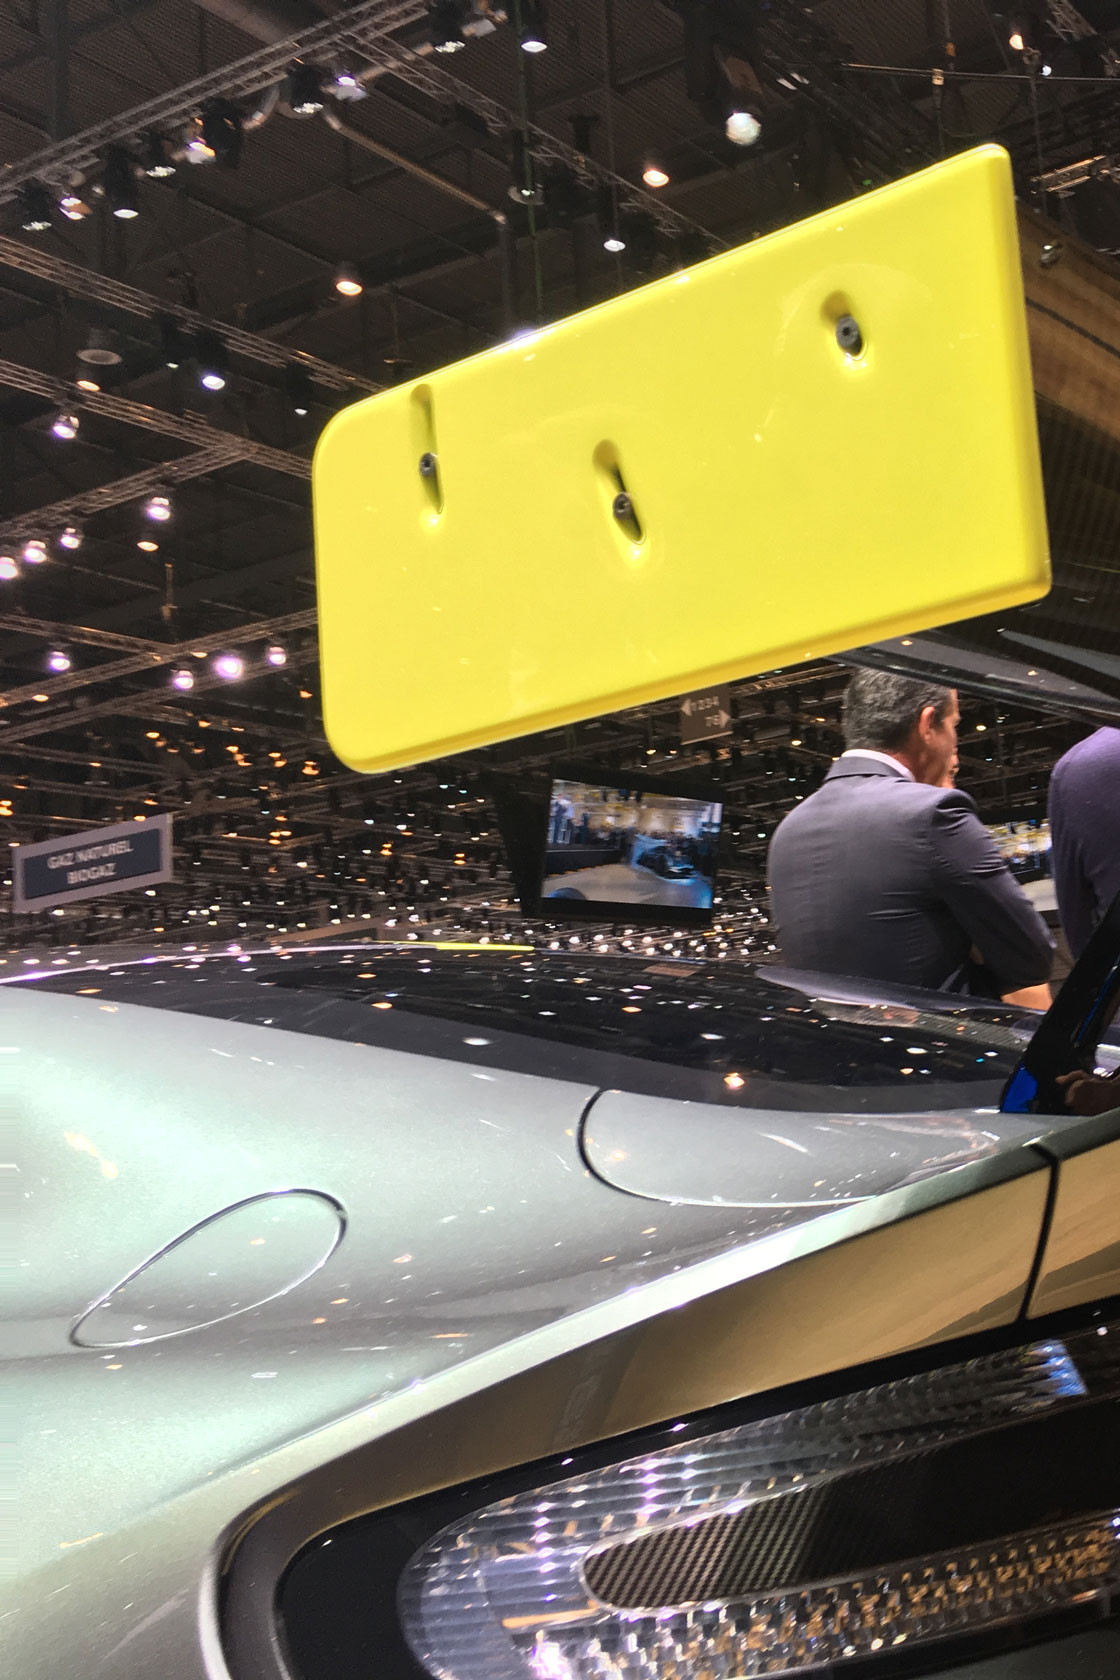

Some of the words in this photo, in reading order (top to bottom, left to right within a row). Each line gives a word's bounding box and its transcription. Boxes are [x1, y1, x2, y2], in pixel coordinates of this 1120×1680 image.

[47, 853, 75, 869] GAZ
[76, 840, 134, 862] NATUREL
[67, 862, 116, 884] BIOGAZ
